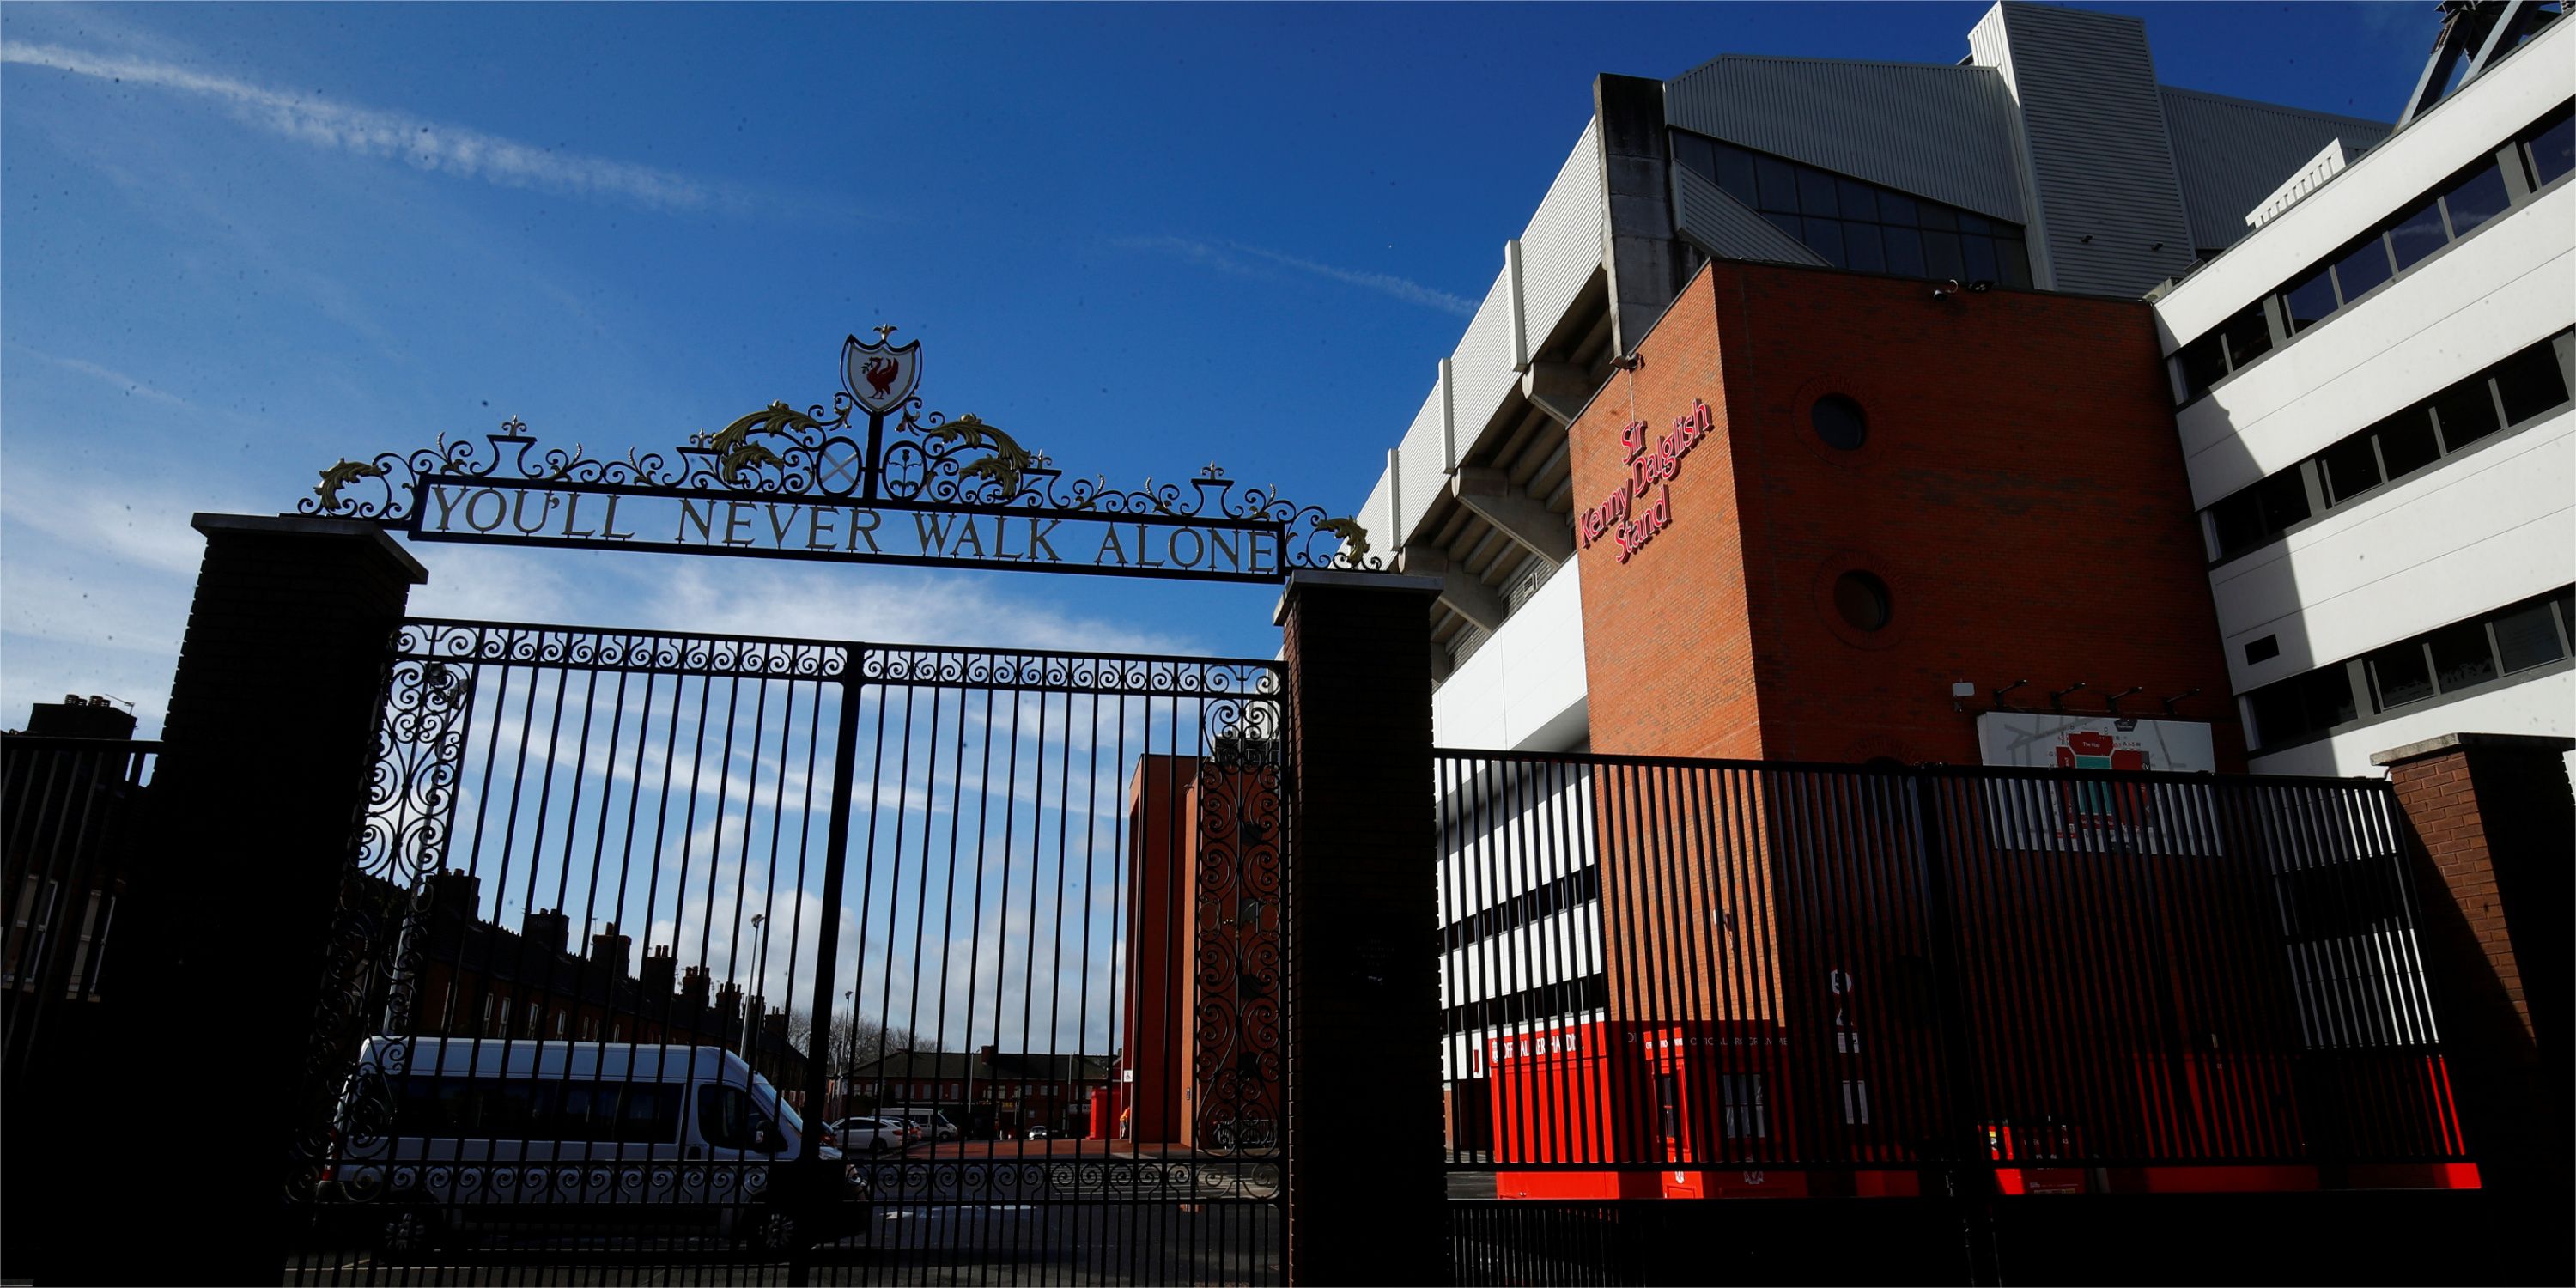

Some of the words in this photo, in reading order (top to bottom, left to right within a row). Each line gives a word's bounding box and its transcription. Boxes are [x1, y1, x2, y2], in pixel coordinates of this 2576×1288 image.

[1580, 479, 1631, 548] Kenny
[1632, 398, 1712, 497] Dalglish
[1621, 421, 1646, 465] Sir
[431, 486, 635, 540] YOU'LL
[674, 499, 883, 553] NEVER
[912, 511, 1062, 562] WALK
[1093, 522, 1278, 573] ALONE
[1614, 484, 1670, 562] Stand
